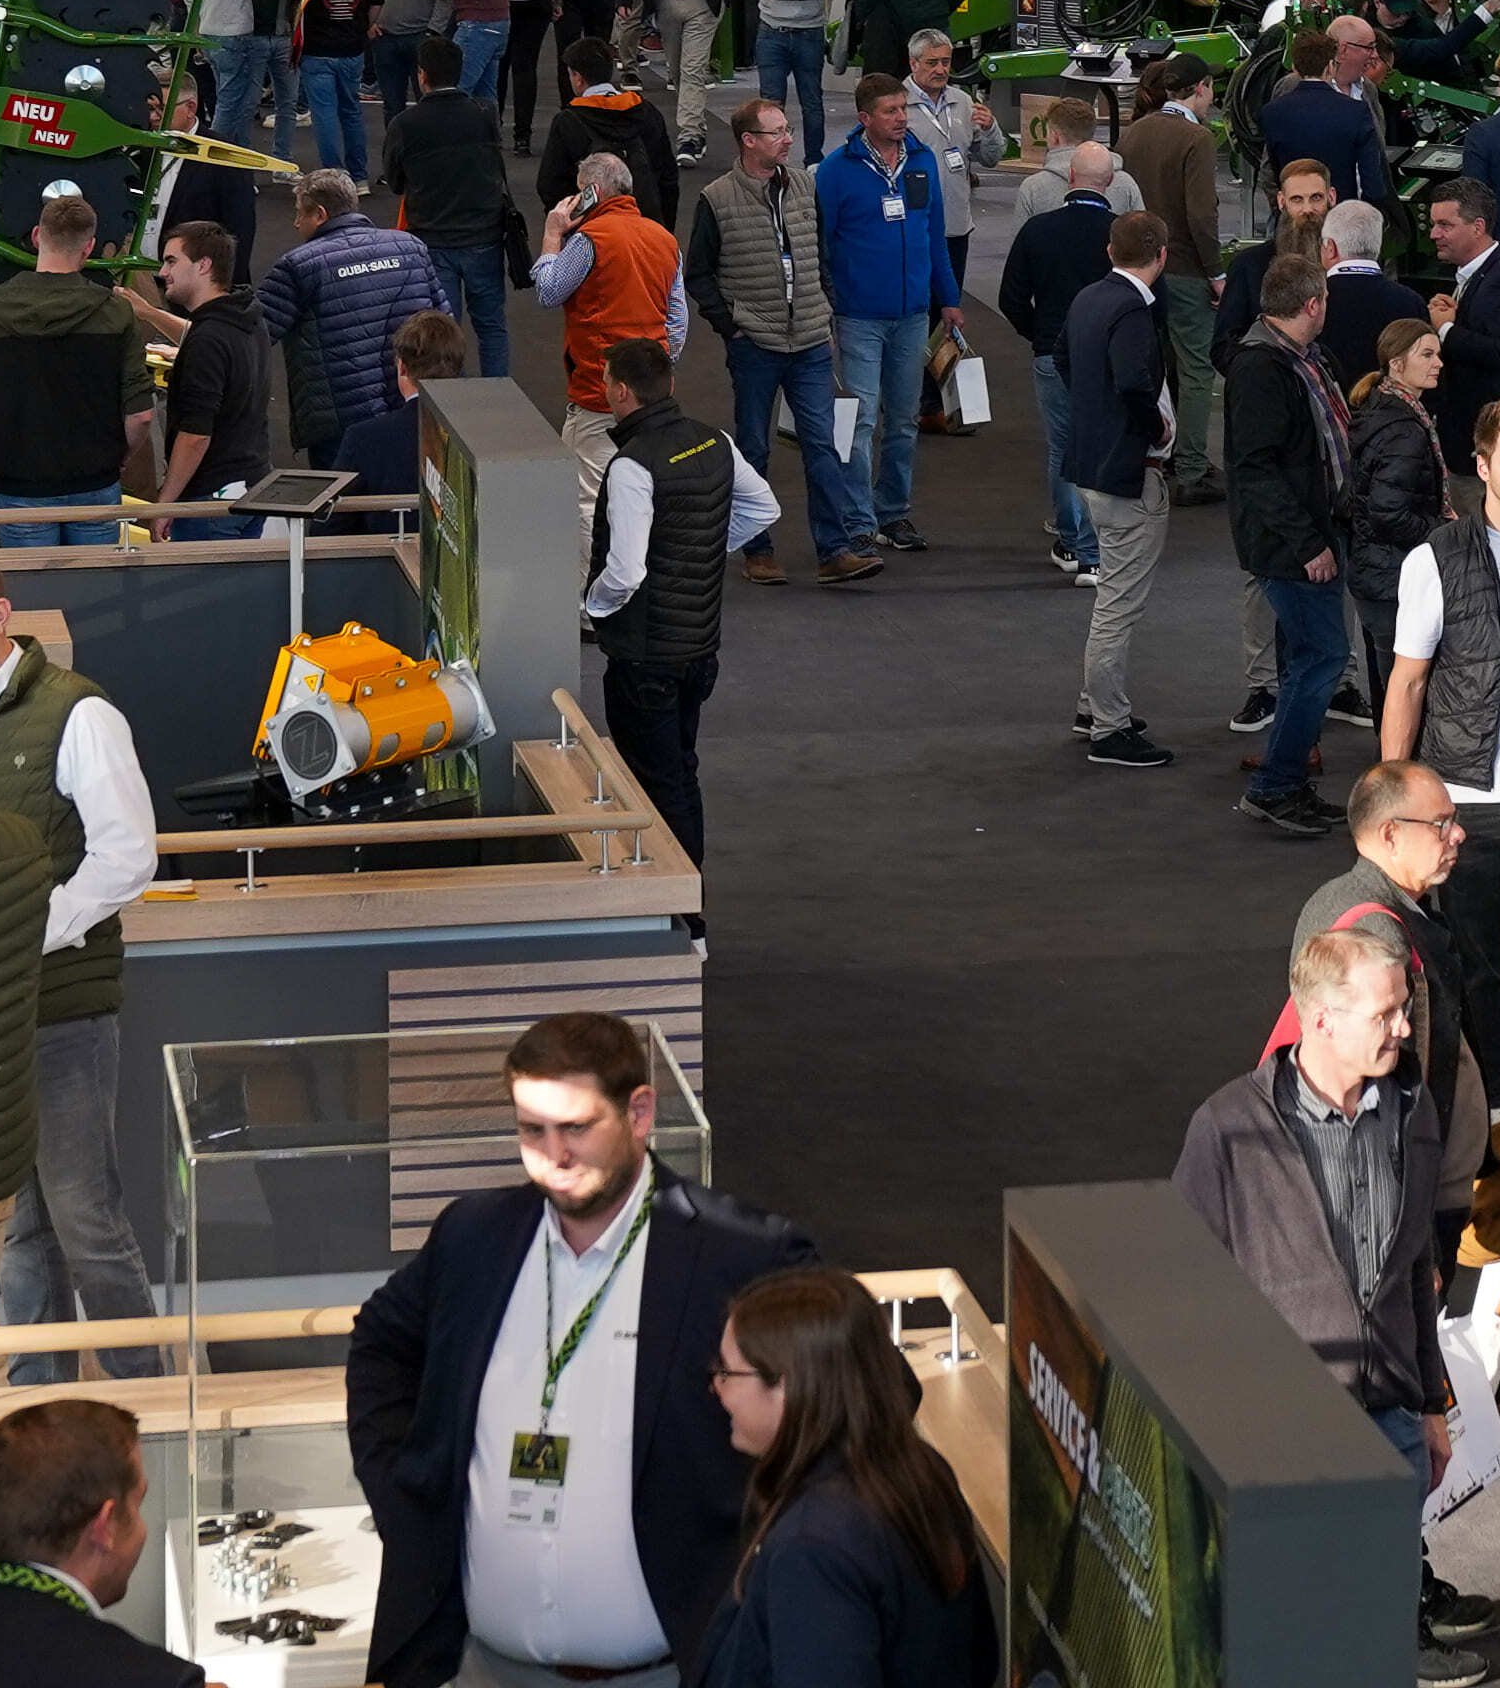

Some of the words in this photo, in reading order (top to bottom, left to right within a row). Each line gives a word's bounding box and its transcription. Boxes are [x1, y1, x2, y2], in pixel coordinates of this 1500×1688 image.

[12, 100, 55, 122] NEU
[34, 129, 70, 146] NEW
[370, 257, 401, 273] SAILS
[1028, 1341, 1087, 1476] SERVICE
